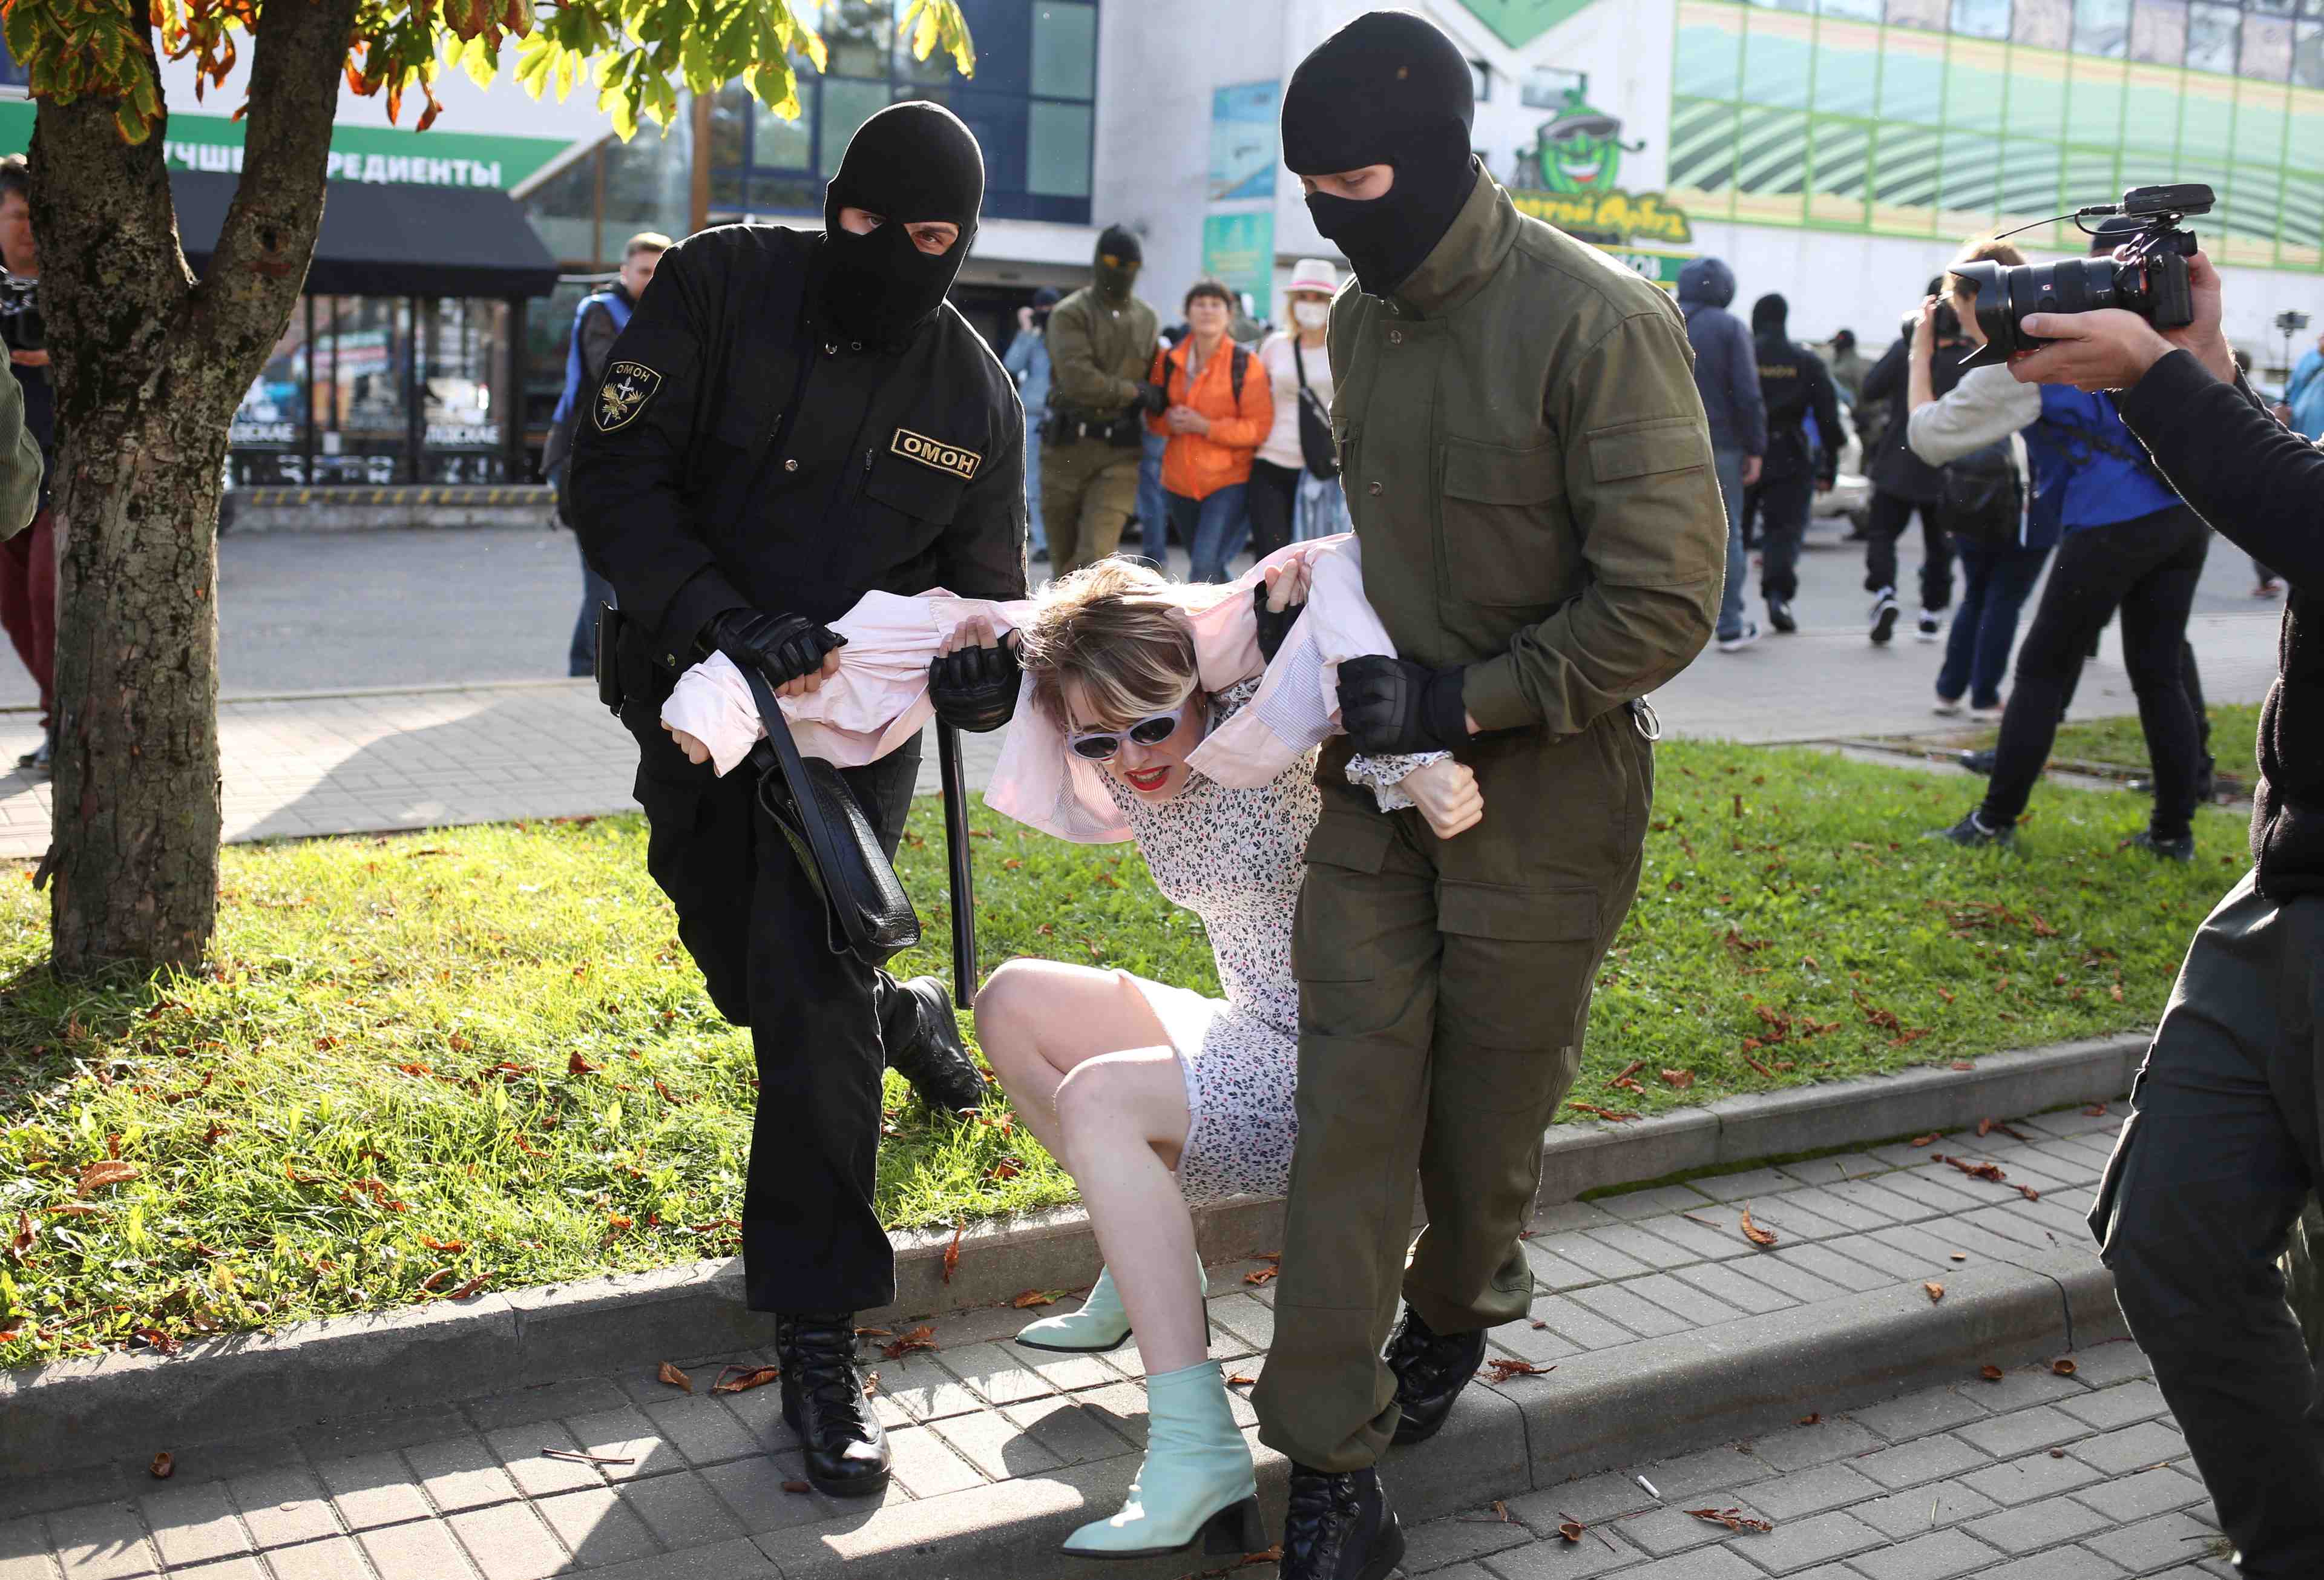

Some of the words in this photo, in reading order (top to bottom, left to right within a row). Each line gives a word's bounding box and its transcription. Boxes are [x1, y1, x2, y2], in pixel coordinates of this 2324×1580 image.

[163, 140, 244, 174] УЧШ
[326, 151, 501, 188] РЕДИЕНТЫ
[616, 364, 651, 382] ОМОН
[904, 437, 974, 473] ОМОН
